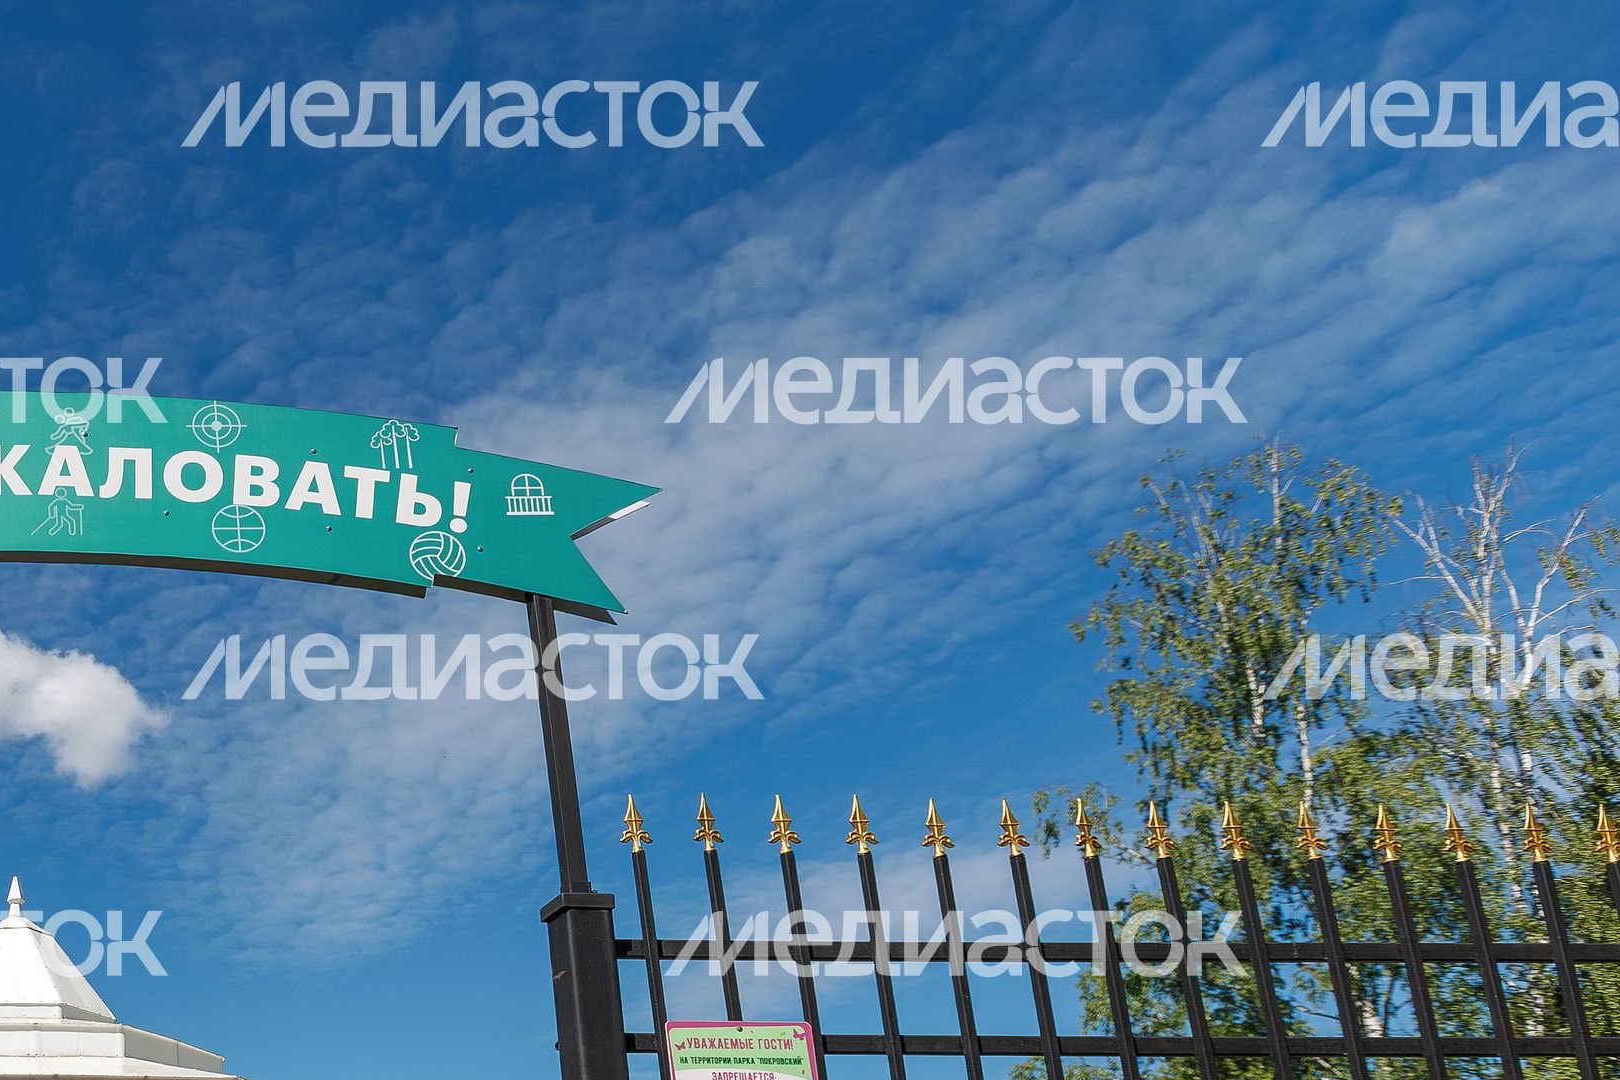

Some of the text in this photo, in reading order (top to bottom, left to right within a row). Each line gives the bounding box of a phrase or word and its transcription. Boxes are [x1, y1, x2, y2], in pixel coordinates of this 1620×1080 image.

[686, 1037, 793, 1050] УВАЖАЕМЫЕ ГОСТИ!
[690, 1057, 731, 1065] ТЕРРИТОРИИ
[733, 1057, 755, 1065] ПАРКА
